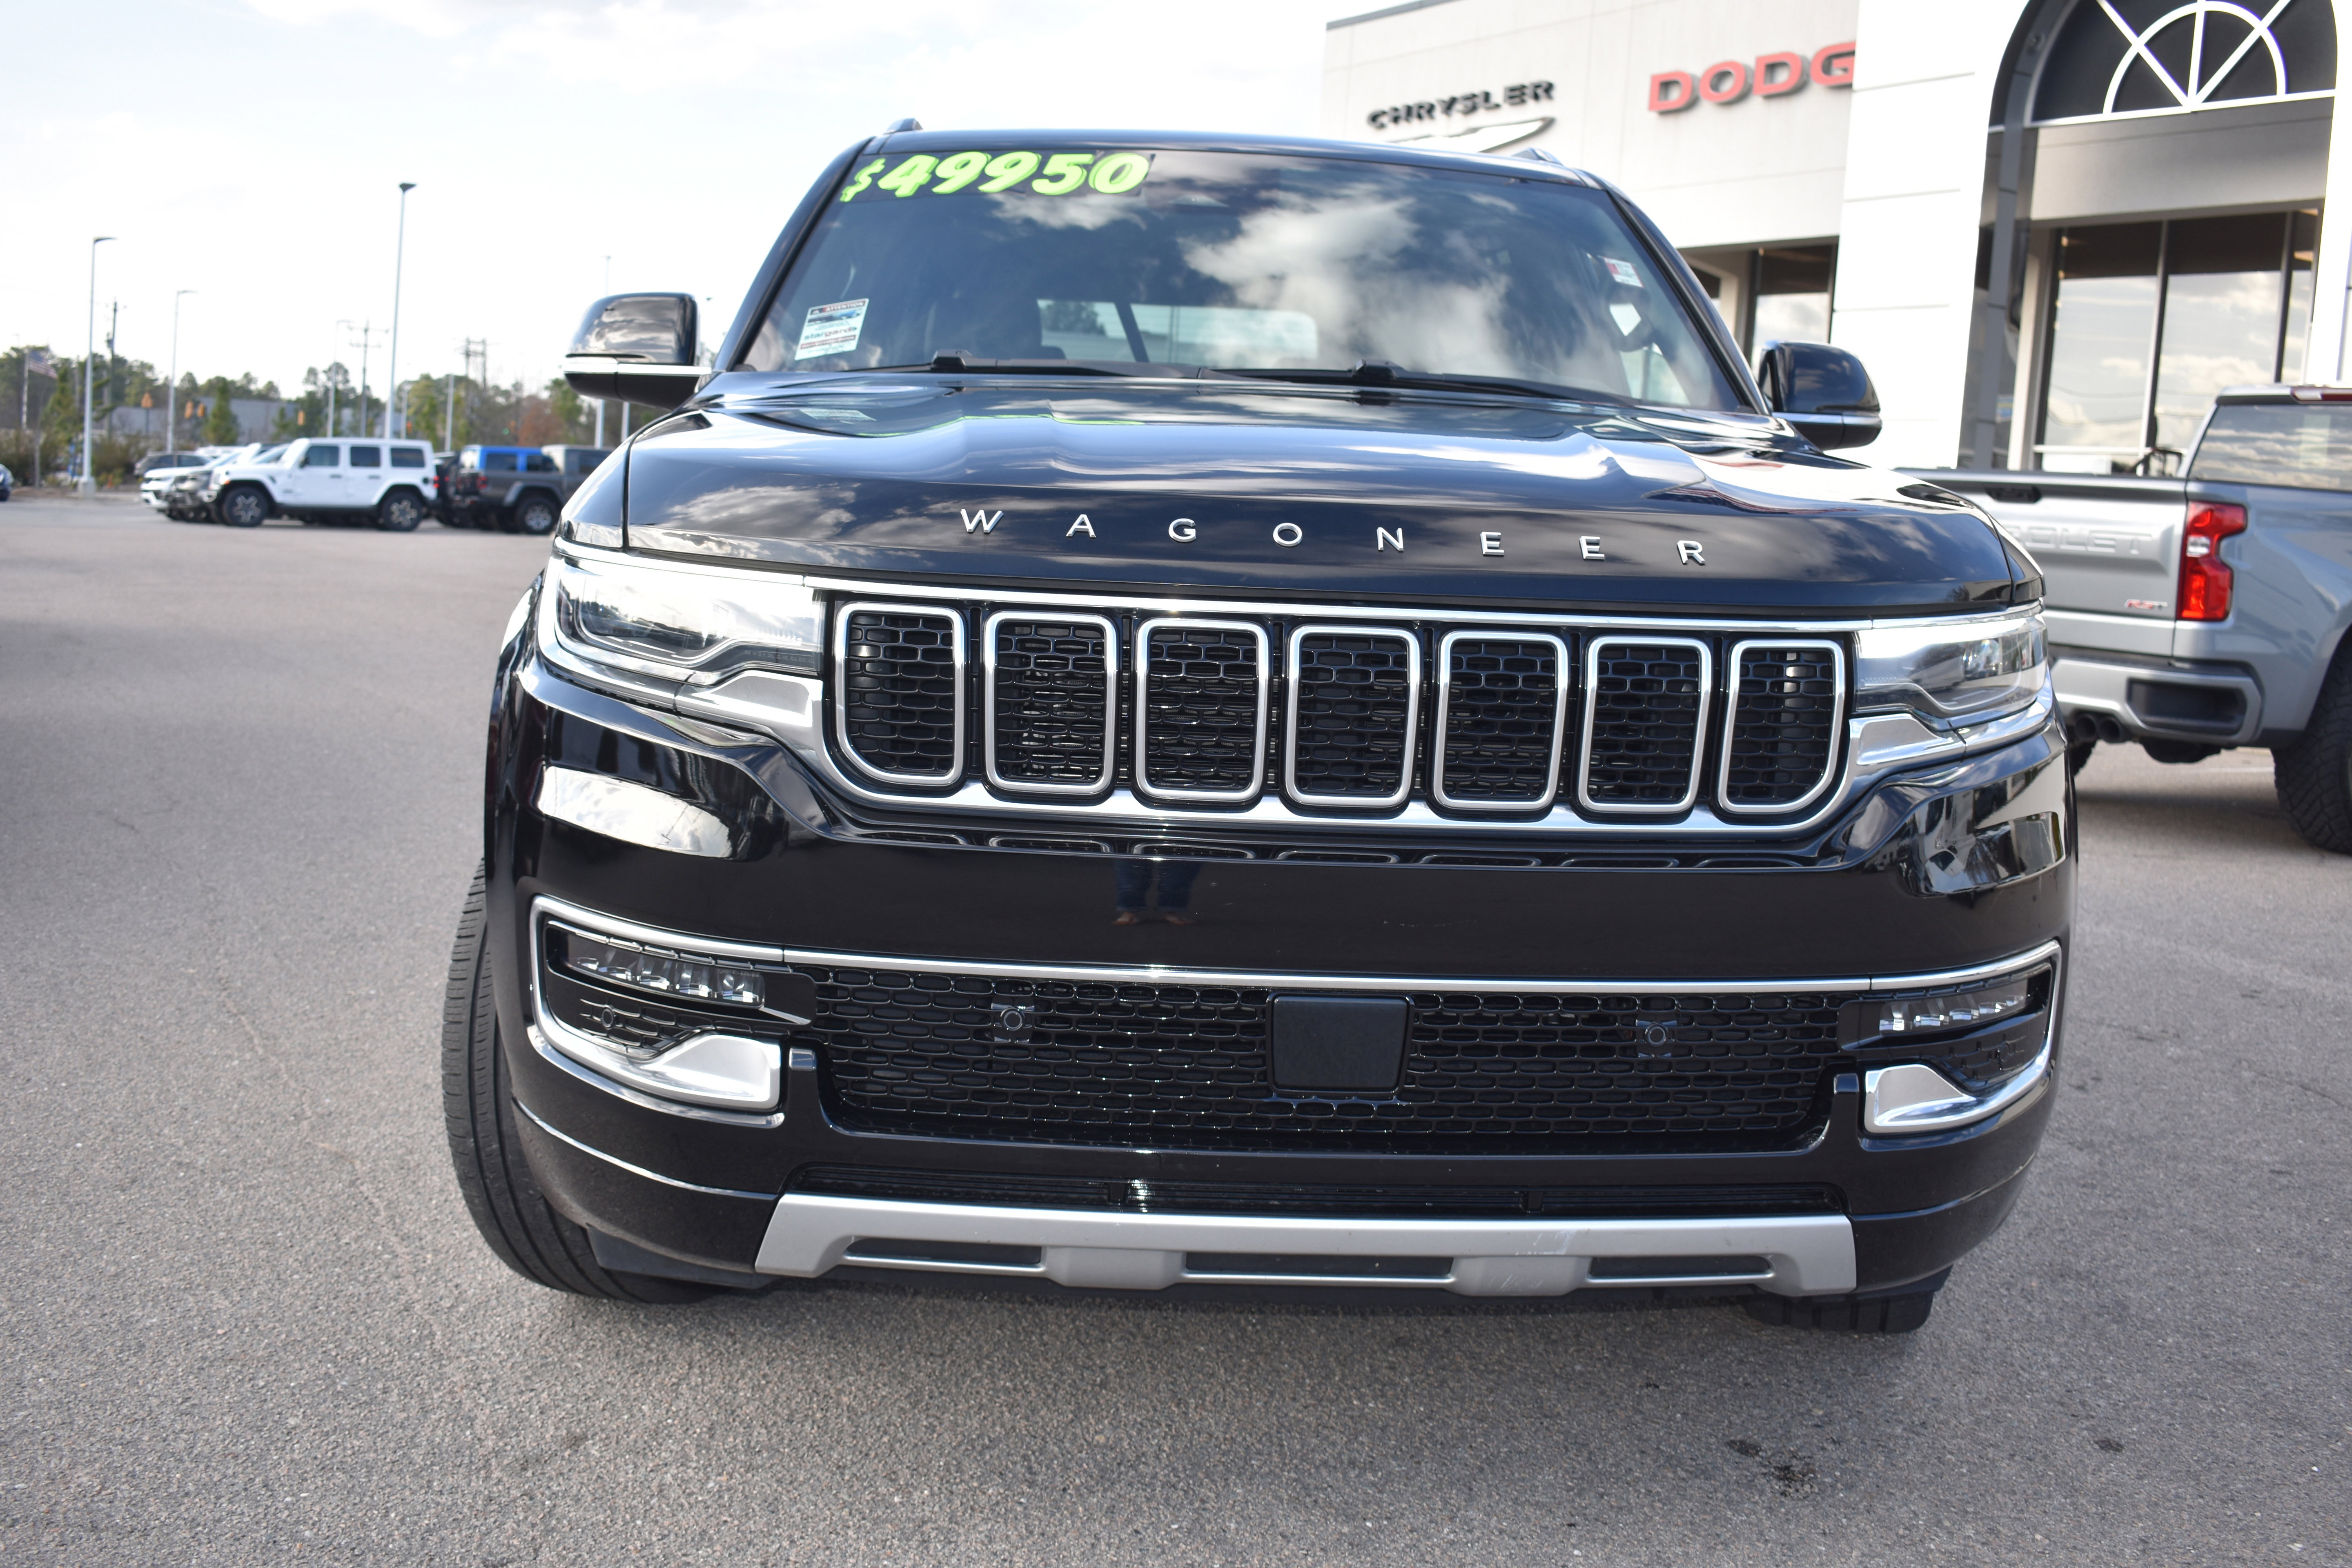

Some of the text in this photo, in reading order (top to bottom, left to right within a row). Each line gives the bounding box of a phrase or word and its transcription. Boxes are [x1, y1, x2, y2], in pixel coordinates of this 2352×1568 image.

[1368, 81, 1556, 129] CHRYSLER
[840, 151, 1149, 203] $49950
[960, 508, 1705, 566] WAGONEER
